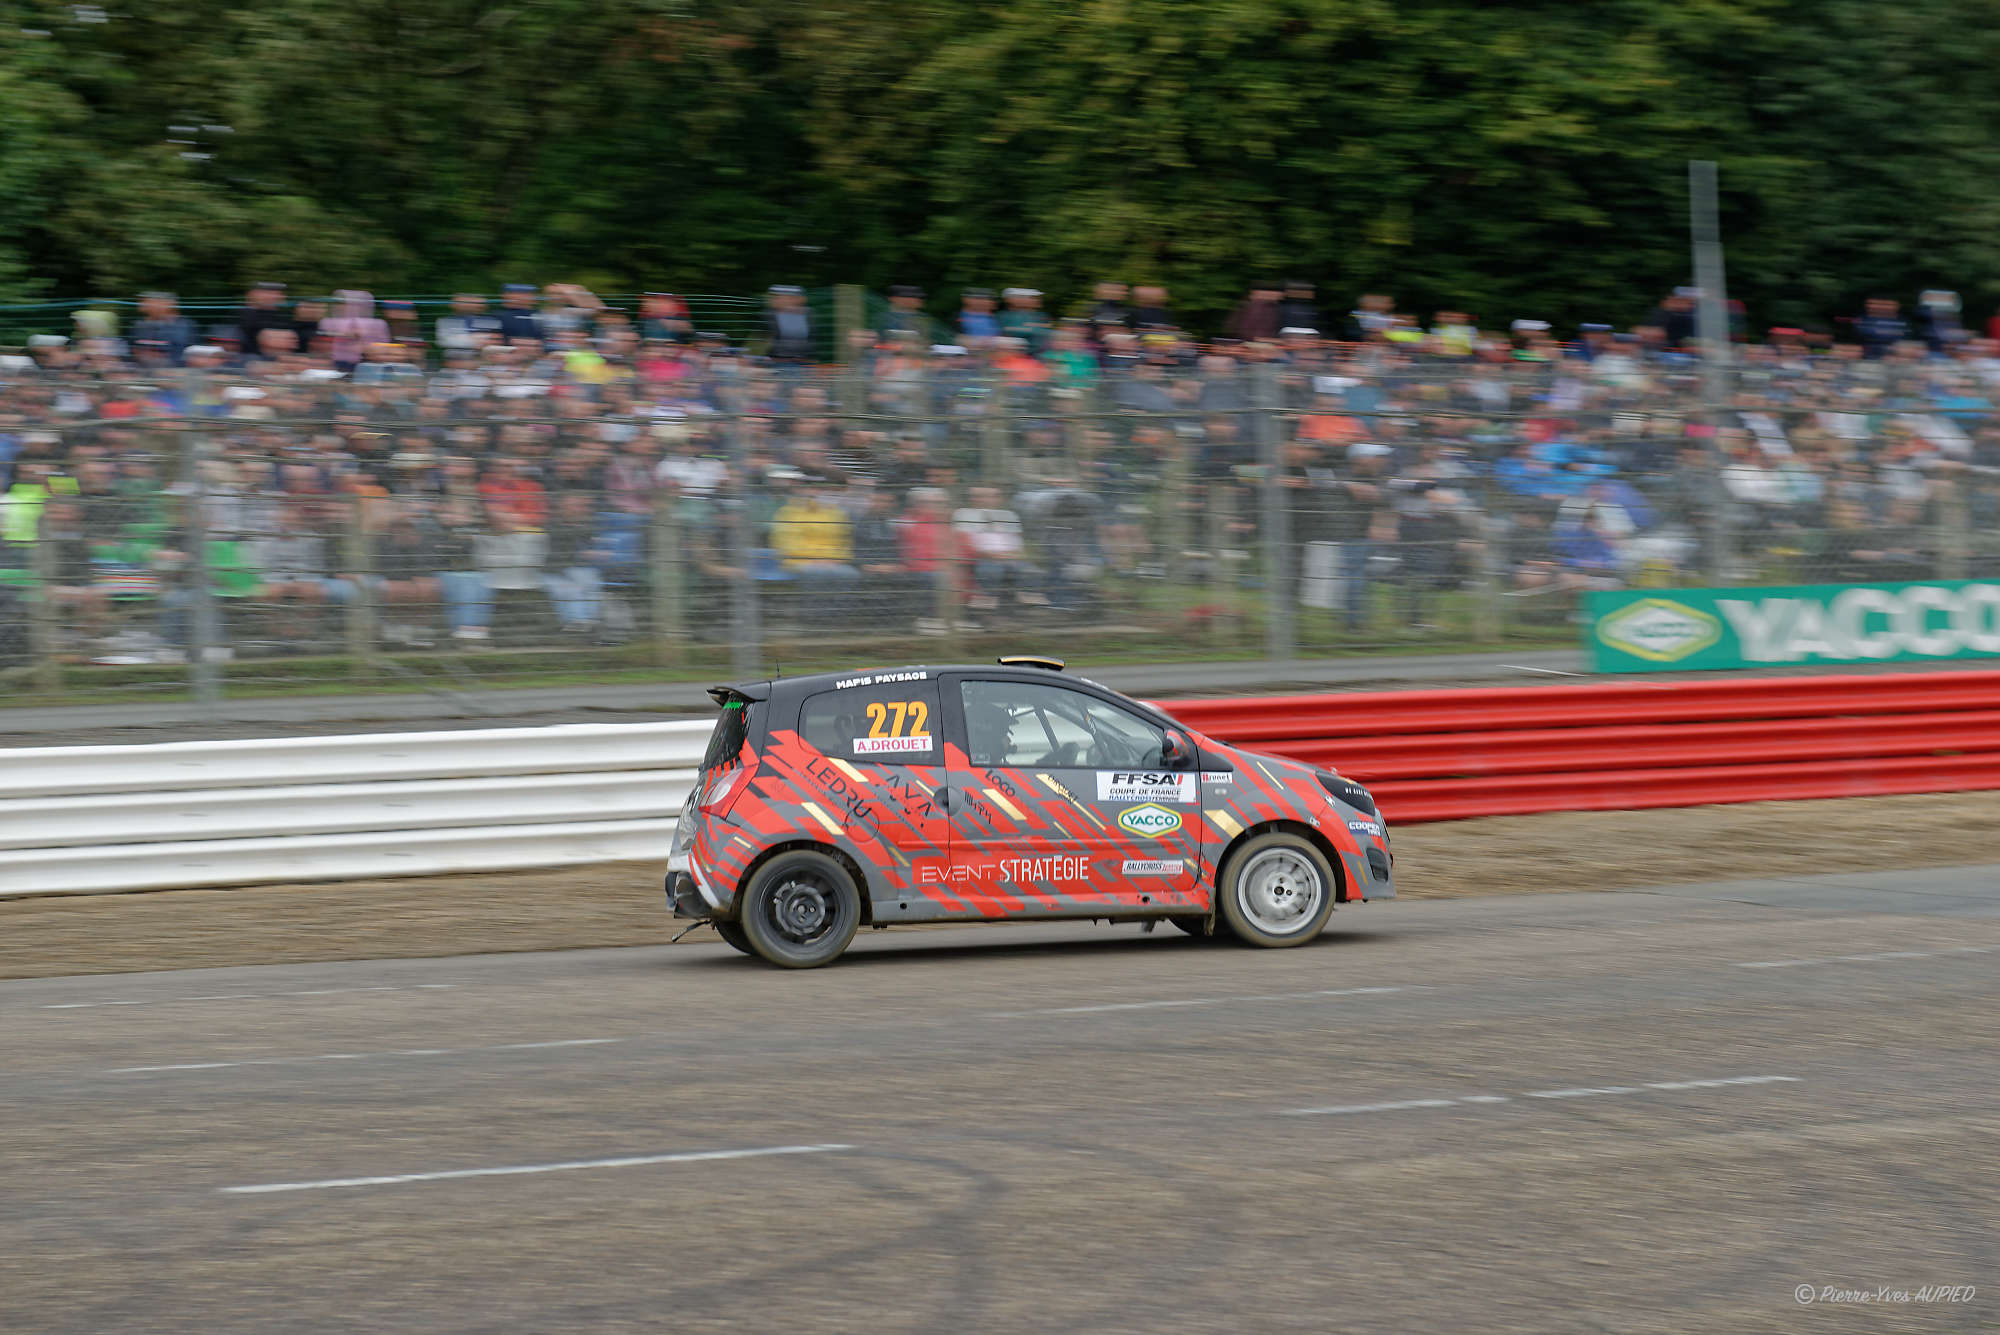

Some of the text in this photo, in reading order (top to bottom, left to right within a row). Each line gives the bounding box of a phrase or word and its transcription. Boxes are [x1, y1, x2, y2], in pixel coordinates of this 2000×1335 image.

[1713, 583, 2000, 662] YACCO
[875, 671, 928, 684] PAYSAGE
[866, 700, 930, 739] 272
[857, 738, 929, 752] A.DROUET
[1111, 773, 1176, 786] FFSA
[1109, 787, 1181, 797] COUPE DE FRANCE
[1128, 815, 1175, 826] YACCO
[921, 863, 997, 883] EVENT
